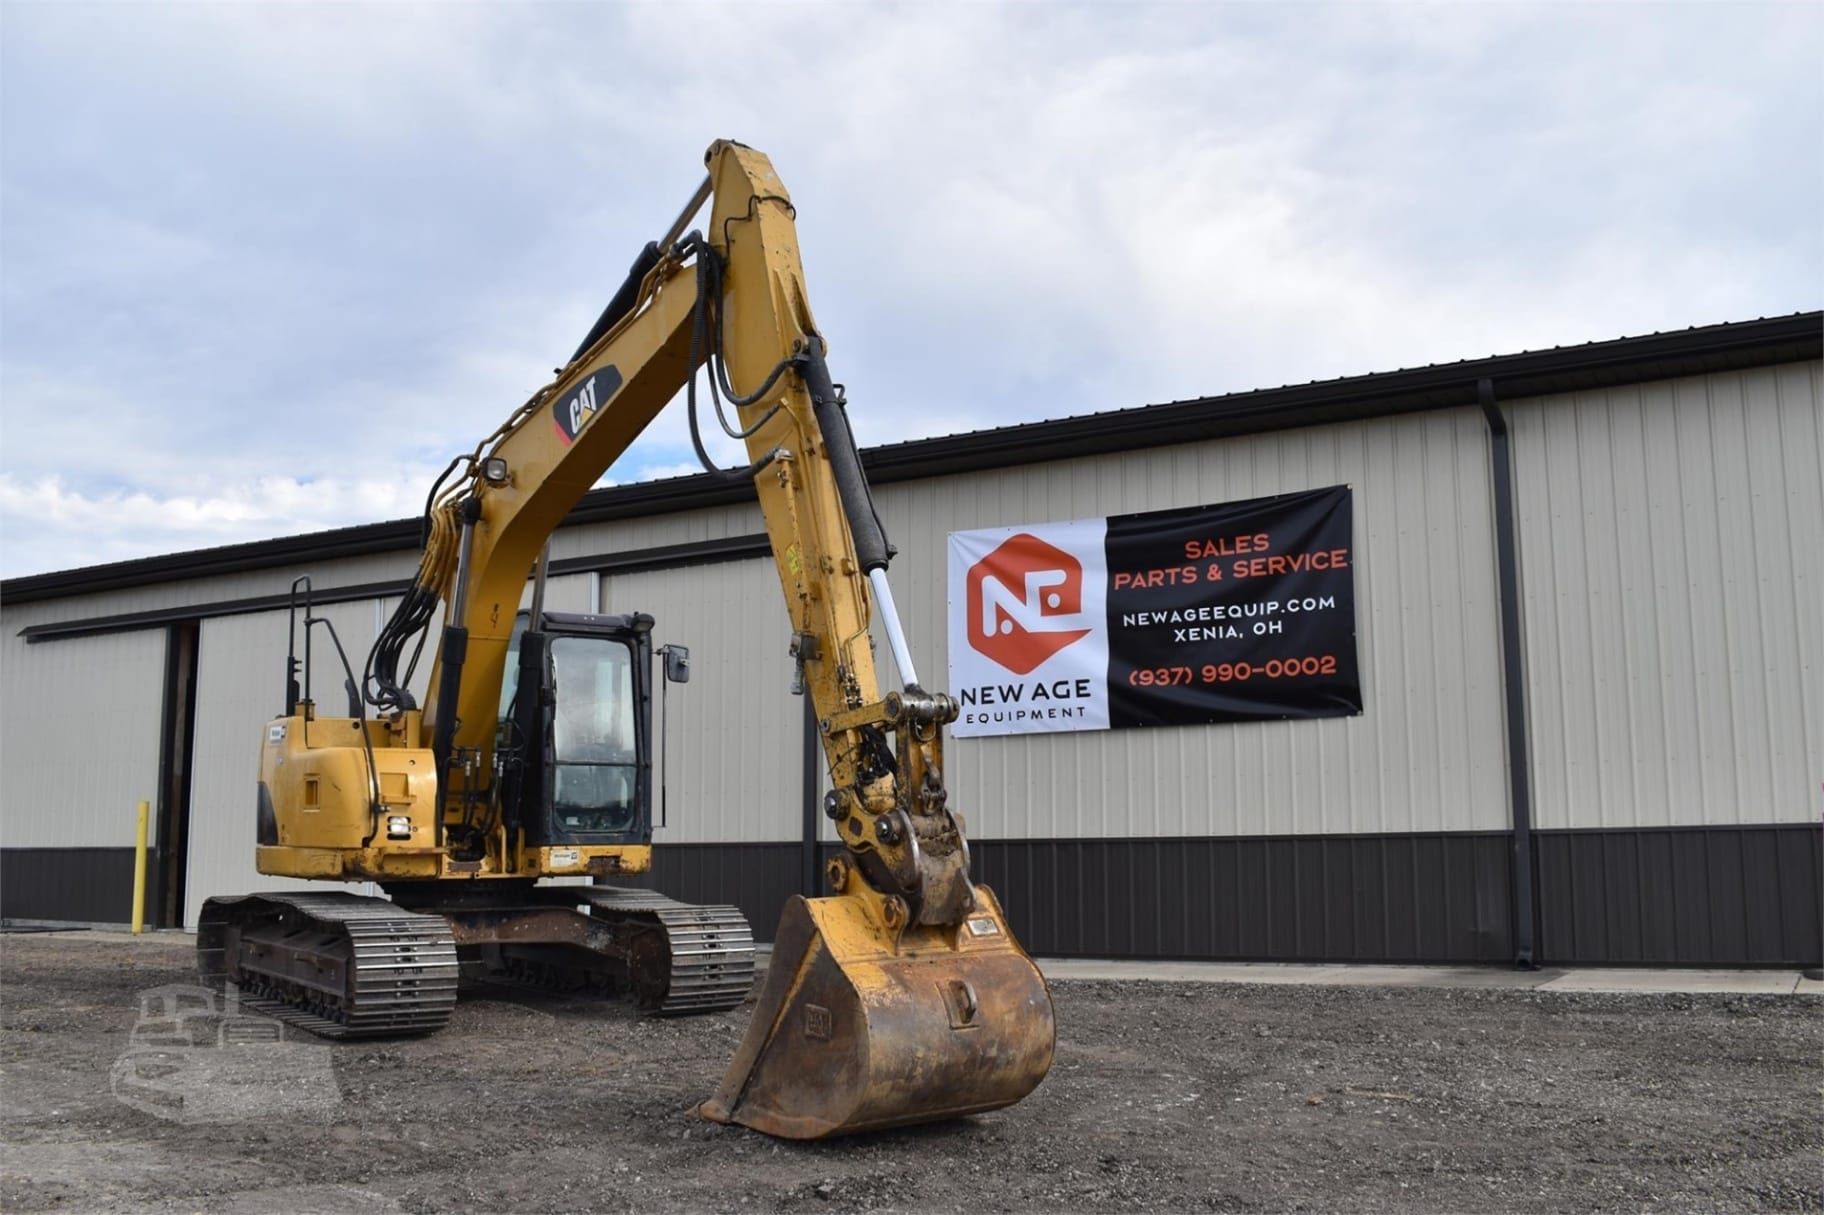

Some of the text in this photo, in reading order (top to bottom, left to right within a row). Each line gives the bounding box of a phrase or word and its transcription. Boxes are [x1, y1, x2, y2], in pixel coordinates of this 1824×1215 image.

[569, 375, 598, 434] CAT
[1184, 533, 1270, 560] SALES
[1114, 548, 1348, 590] PARTS & SERVICE
[1122, 595, 1336, 628] NEWAGEEQUIP.COM
[1174, 619, 1283, 643] XENIA, OH
[1128, 654, 1337, 687] (937) 990-0002
[960, 678, 1092, 707] NEW AGE
[966, 706, 1086, 725] EQUIPMENT
